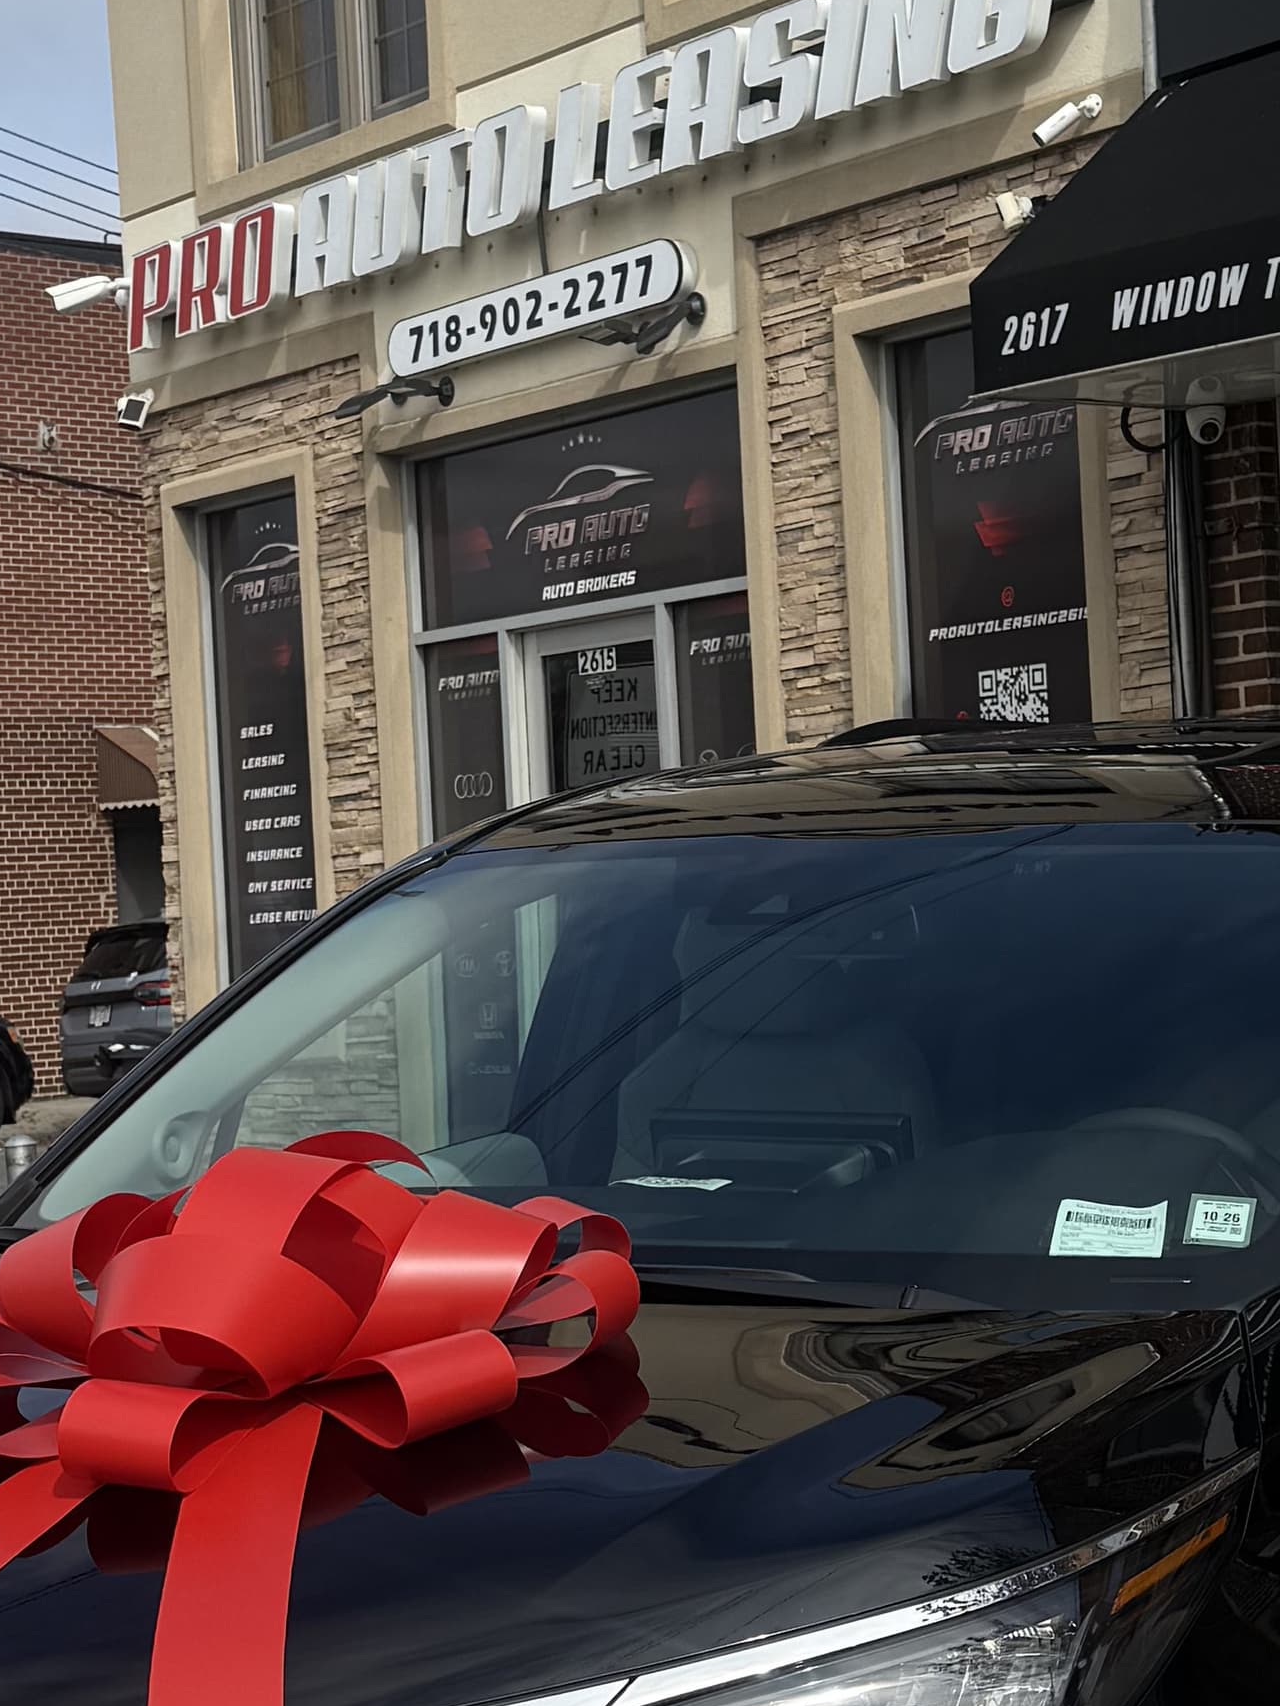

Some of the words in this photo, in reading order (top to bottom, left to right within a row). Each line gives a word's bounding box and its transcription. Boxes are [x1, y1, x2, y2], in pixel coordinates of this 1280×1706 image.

[128, 202, 295, 354] PRO
[294, 104, 548, 299] AUTO
[409, 252, 654, 365] 718-902-2277
[1001, 302, 1069, 356] 2617
[1111, 263, 1249, 331] WINDOW
[934, 423, 992, 461] PRO
[996, 406, 1076, 447] AUTO
[956, 442, 1054, 475] LEASING
[525, 518, 577, 556] PRO
[580, 503, 651, 544] AUTO
[544, 543, 632, 573] LEASING
[231, 579, 265, 604] PRO
[267, 573, 299, 597] AUT
[542, 583, 575, 601] AUTO
[576, 570, 637, 595] BROKERS
[690, 637, 721, 656] PRO
[579, 649, 615, 674] 2615
[438, 675, 464, 691] PRO
[239, 723, 274, 739] SALES
[241, 753, 285, 770] LEASING
[243, 783, 297, 801] FINANCING
[244, 817, 272, 832] USED
[273, 814, 301, 829] CARS
[246, 846, 303, 863] INSURANCE
[248, 881, 269, 893] DMV
[270, 878, 313, 892] SERVICE
[249, 911, 283, 925] LEASE
